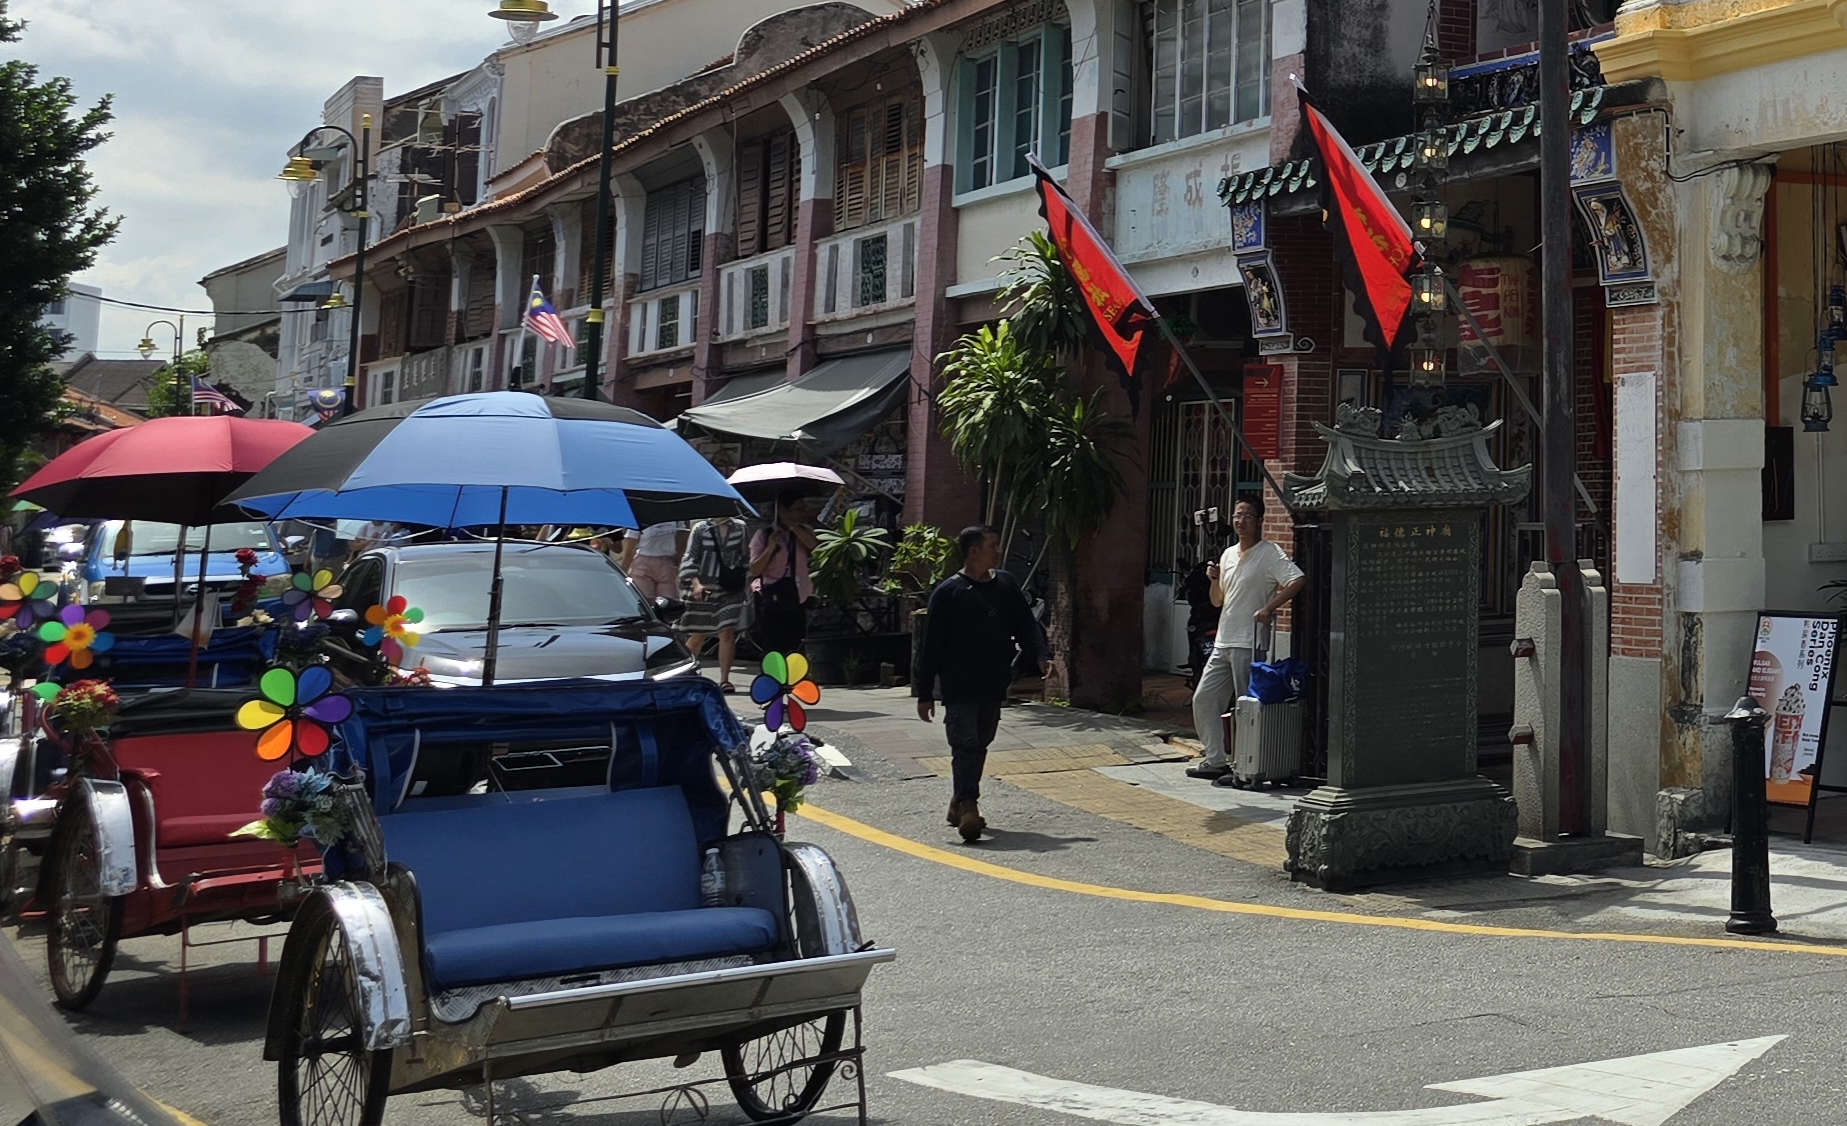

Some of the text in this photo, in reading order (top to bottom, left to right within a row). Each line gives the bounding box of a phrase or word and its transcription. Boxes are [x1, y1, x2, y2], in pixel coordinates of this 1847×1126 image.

[1380, 523, 1452, 538] 福德正神廟
[1806, 620, 1821, 665] Series
[1809, 621, 1830, 692] Dan Cong
[1820, 621, 1838, 680] Phoenix
